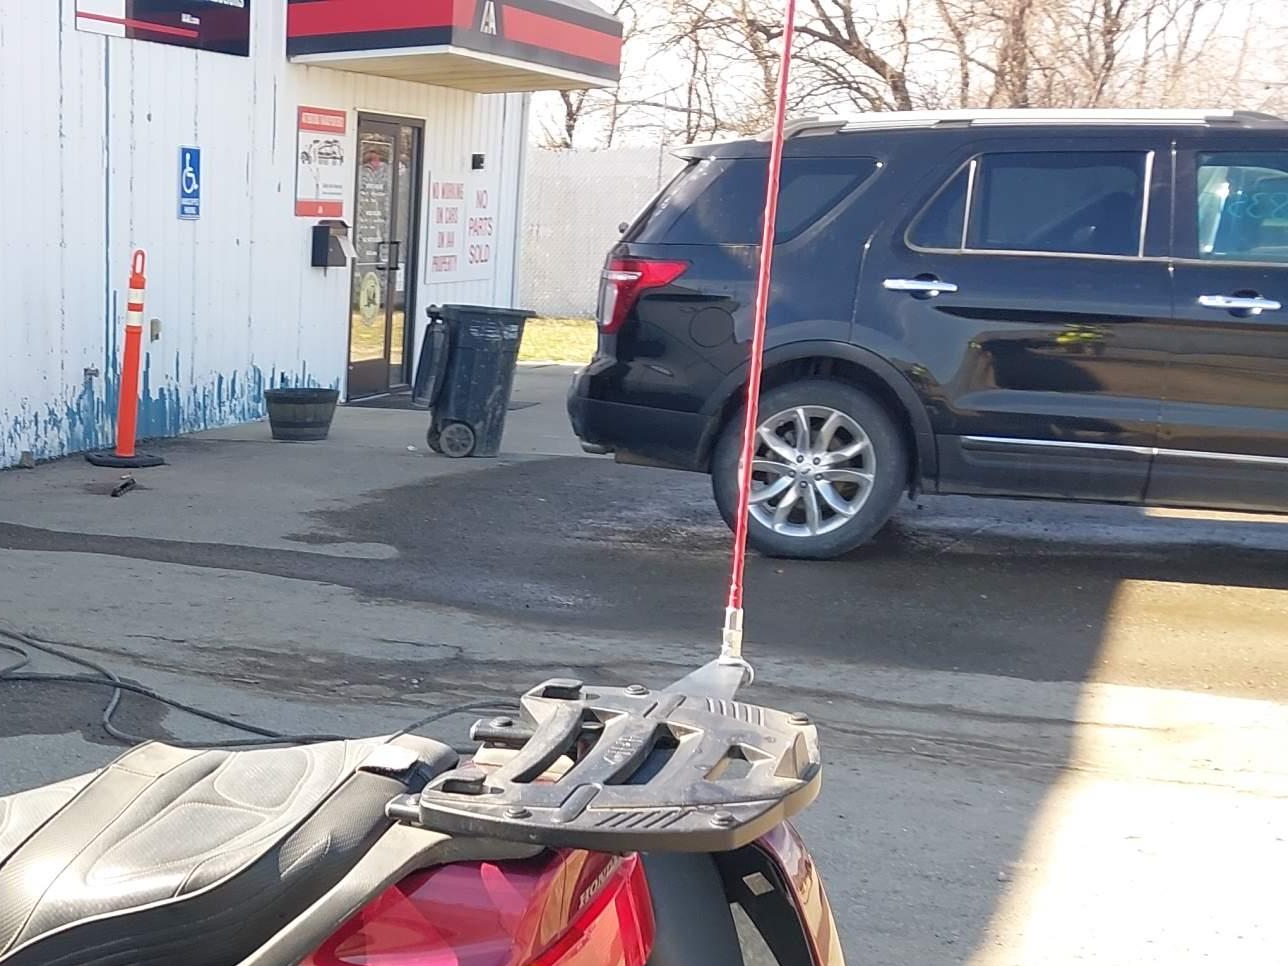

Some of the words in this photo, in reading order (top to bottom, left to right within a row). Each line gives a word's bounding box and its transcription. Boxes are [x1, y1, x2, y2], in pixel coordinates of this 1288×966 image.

[475, 189, 489, 209] NO
[468, 216, 493, 237] PARTS
[469, 243, 491, 265] SOLD
